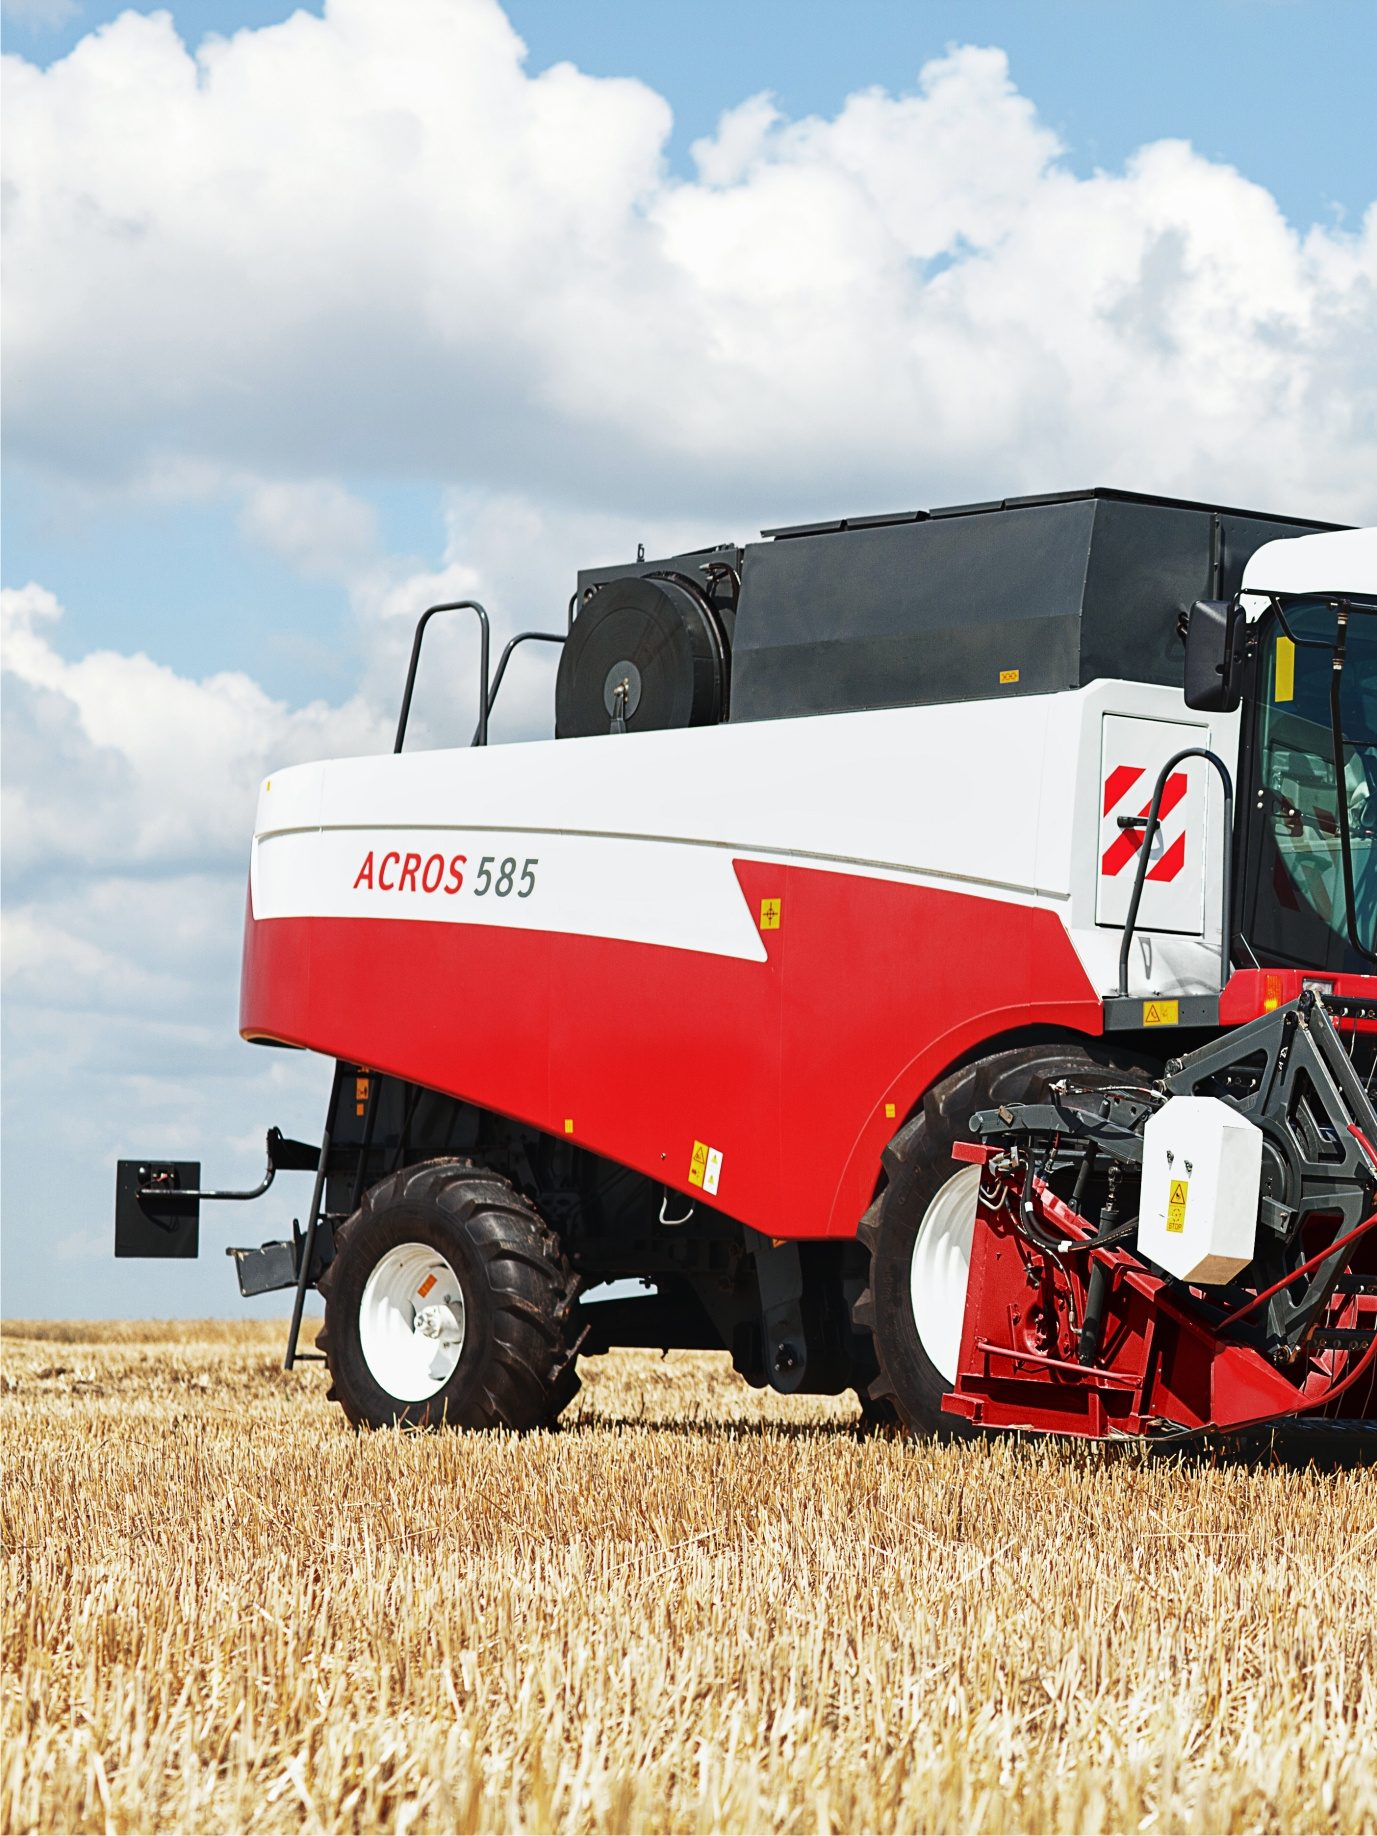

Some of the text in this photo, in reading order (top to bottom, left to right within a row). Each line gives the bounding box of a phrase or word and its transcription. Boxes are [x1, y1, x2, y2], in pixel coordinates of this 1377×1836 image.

[353, 851, 539, 898] ACROS 585
[1168, 1222, 1183, 1230] STOP
